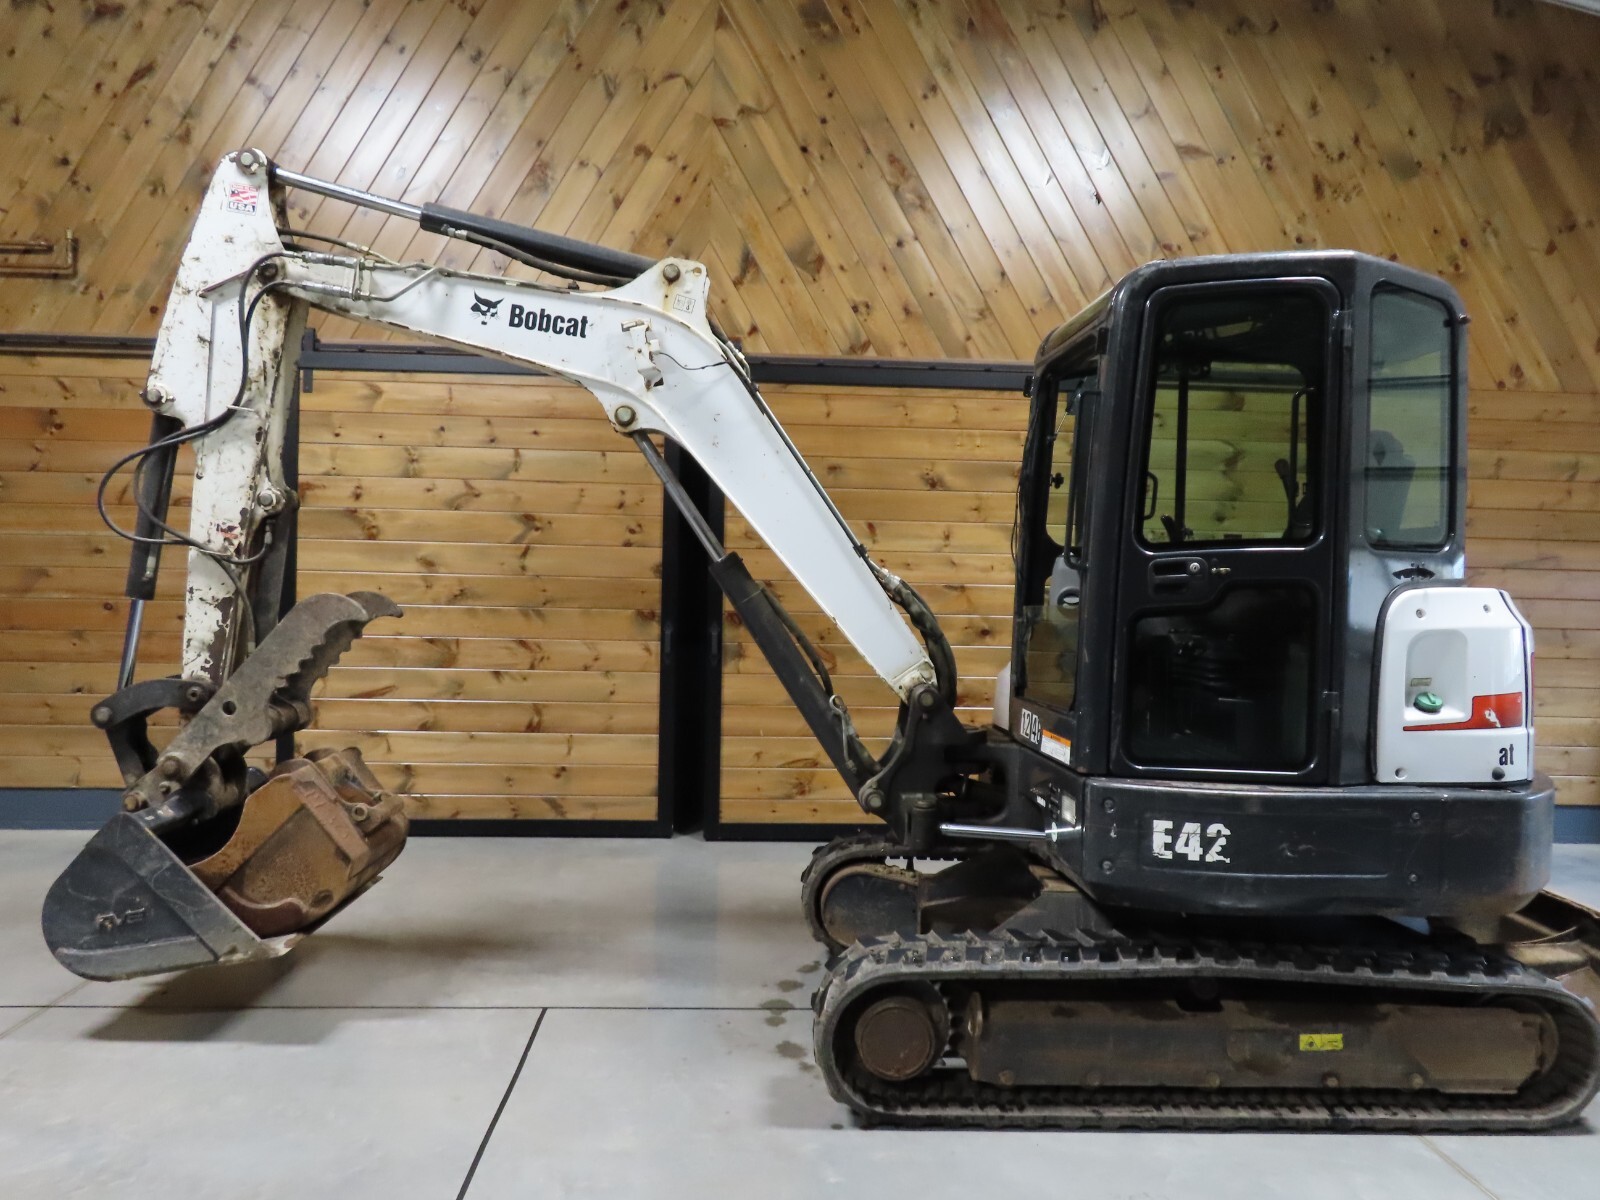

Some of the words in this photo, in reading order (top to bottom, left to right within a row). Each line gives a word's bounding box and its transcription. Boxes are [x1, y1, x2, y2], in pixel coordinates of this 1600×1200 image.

[229, 201, 255, 212] USA
[508, 303, 588, 339] Bobcat
[1498, 743, 1514, 766] at
[1152, 819, 1231, 863] E42
